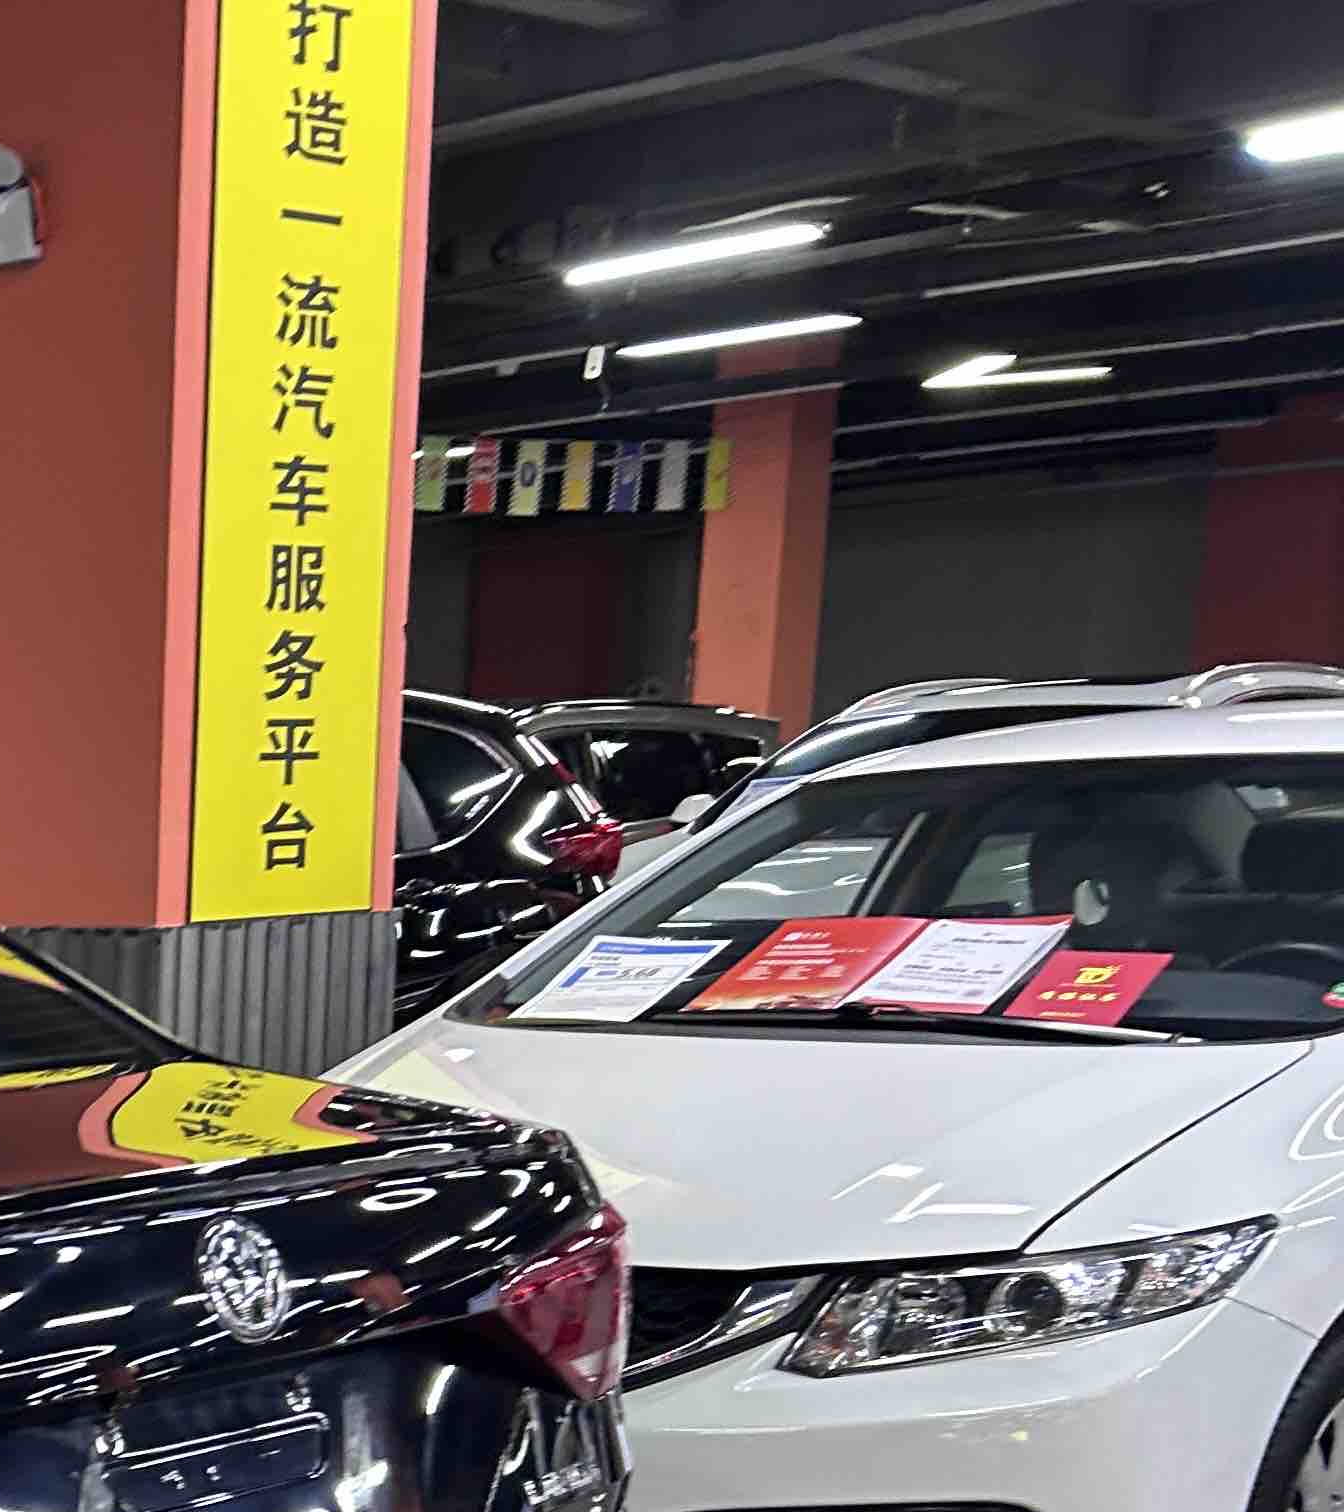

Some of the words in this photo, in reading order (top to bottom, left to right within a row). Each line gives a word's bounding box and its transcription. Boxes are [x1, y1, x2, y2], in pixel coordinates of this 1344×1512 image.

[259, 0, 354, 871] 打造一流汽车服务平台
